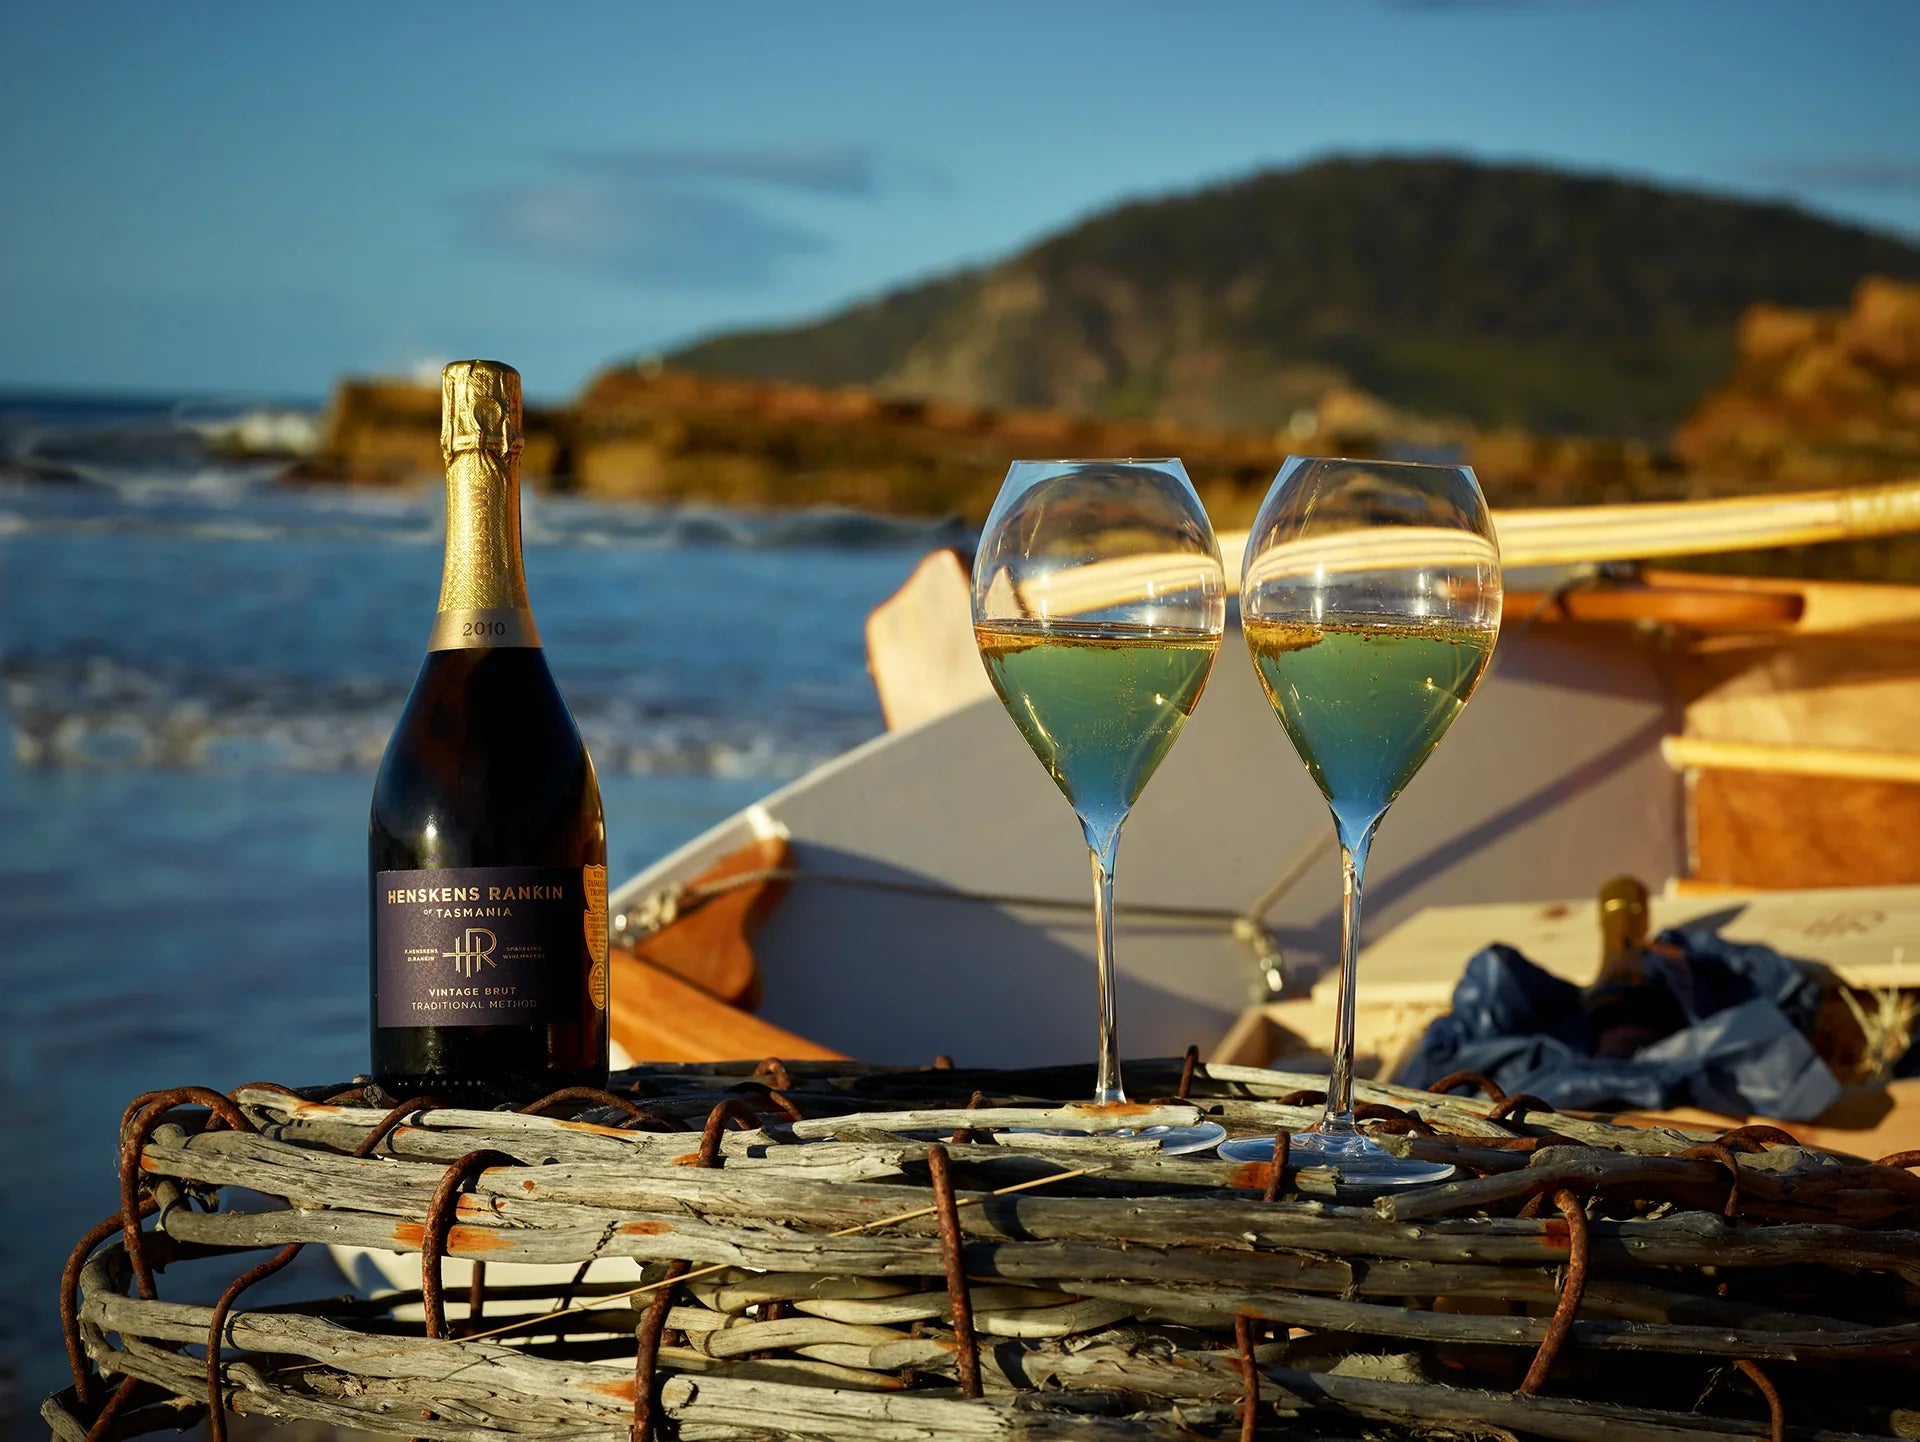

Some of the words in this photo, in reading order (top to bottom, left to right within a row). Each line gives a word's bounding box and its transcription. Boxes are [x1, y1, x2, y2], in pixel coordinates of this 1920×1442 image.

[463, 621, 505, 637] 2010
[387, 886, 480, 904] HENSKENS
[488, 885, 563, 901] RANKIN
[423, 908, 433, 916] OF
[436, 907, 512, 918] TASMANIA
[429, 987, 479, 996] VINTAGE
[484, 986, 516, 996] BRUT
[411, 1001, 485, 1010] TRADITIONAL
[489, 1000, 537, 1009] METHOD
